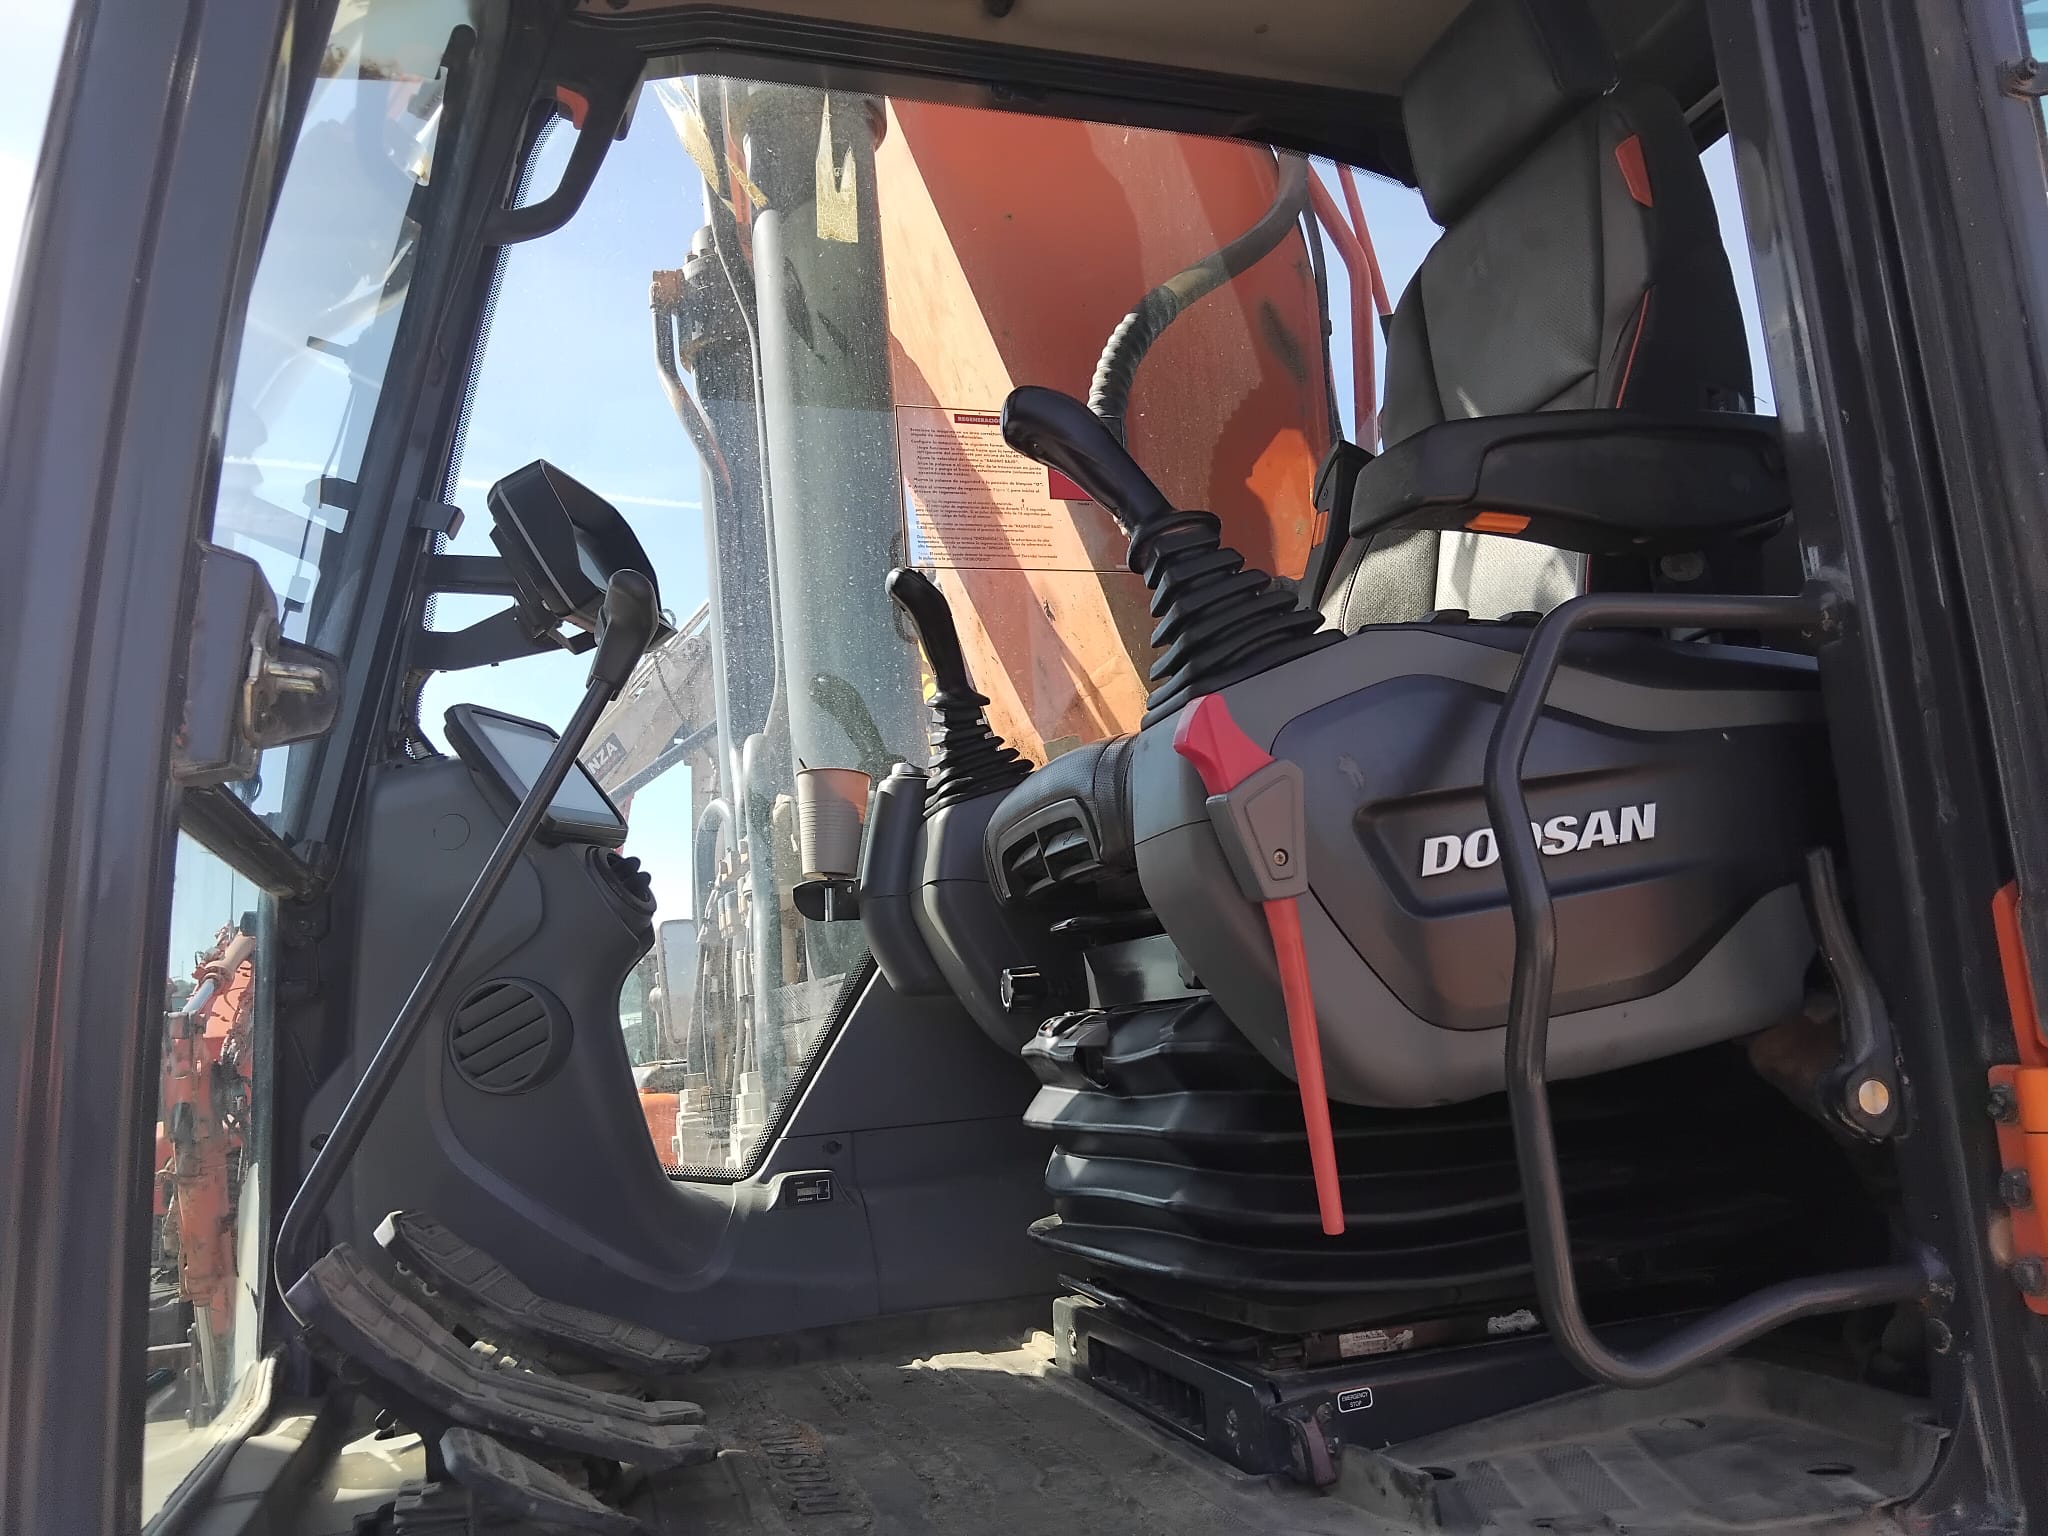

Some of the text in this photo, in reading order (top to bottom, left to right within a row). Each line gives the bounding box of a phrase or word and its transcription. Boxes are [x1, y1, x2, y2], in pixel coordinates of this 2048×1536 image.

[1421, 802, 1656, 877] DOSAN
[1341, 1392, 1368, 1401] EMERGENCY
[1349, 1400, 1362, 1408] STOP
